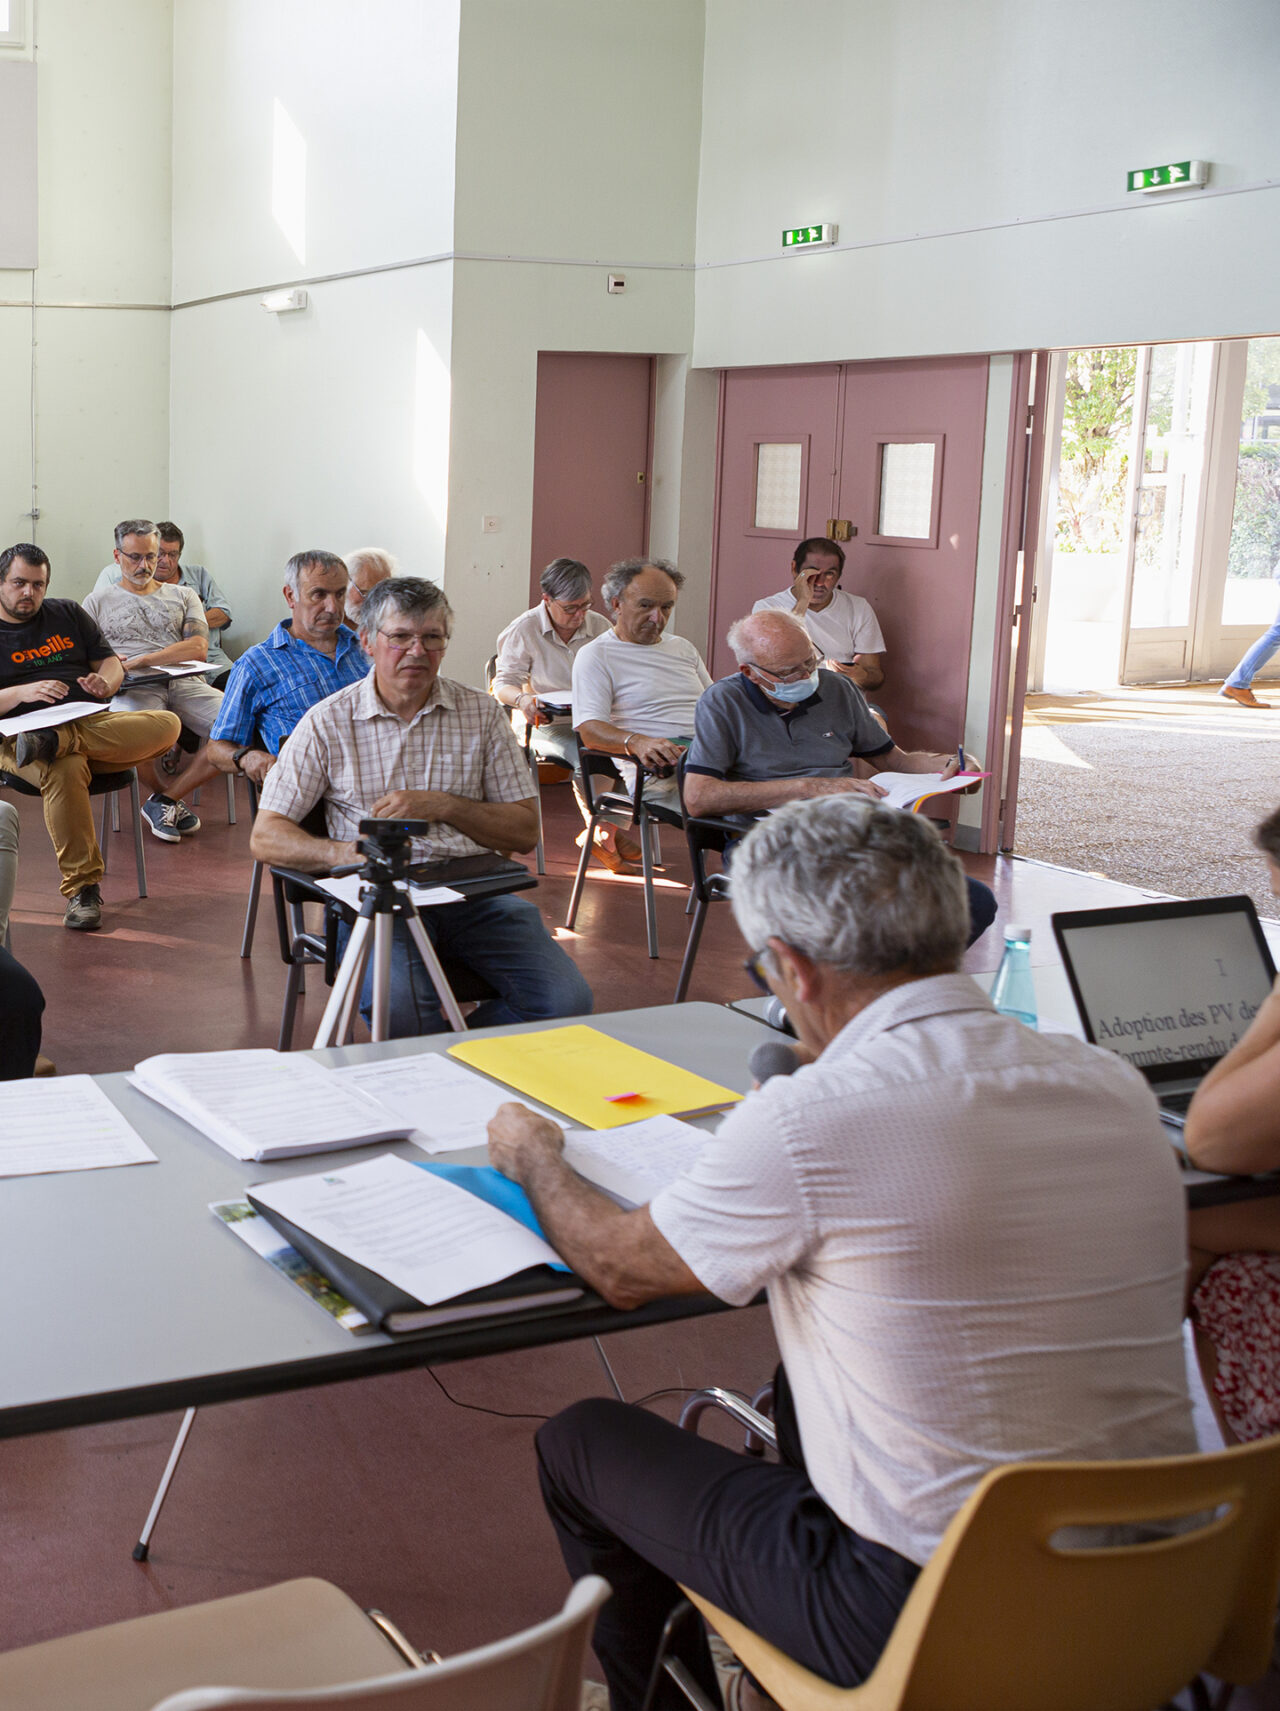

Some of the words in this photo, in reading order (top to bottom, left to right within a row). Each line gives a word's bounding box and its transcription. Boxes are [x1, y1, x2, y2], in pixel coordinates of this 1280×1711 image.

[1098, 1013, 1178, 1041] Adoption
[1179, 1007, 1207, 1028] des
[1207, 1002, 1233, 1024] PV
[1238, 1000, 1261, 1020] de
[1113, 1035, 1229, 1067] ompte-rendu
